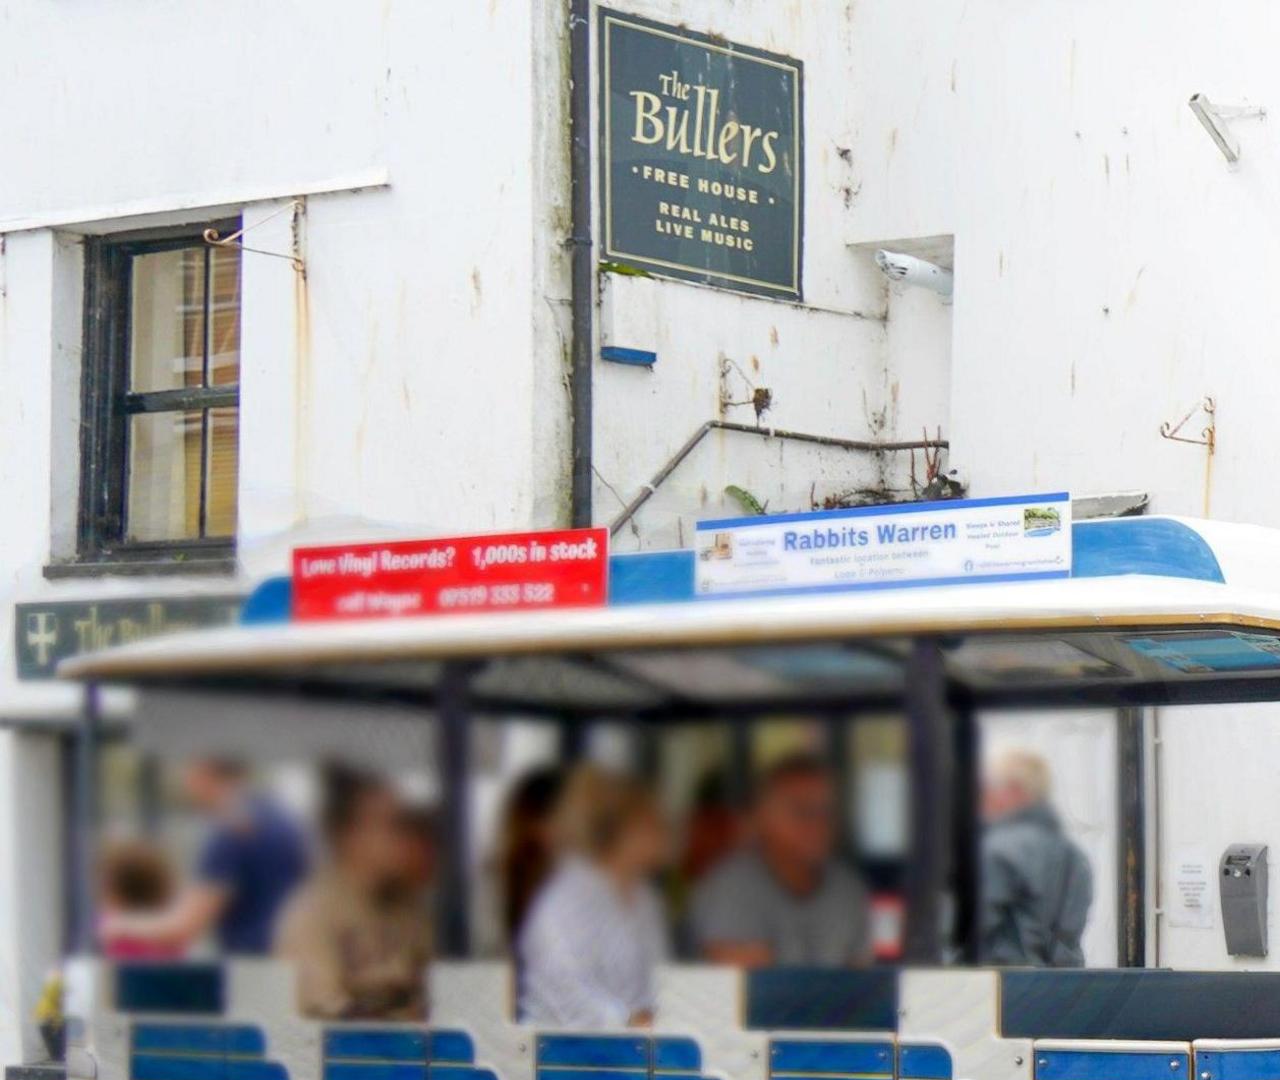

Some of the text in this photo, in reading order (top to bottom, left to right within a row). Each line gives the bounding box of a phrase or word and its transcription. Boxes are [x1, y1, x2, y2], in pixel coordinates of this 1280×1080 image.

[658, 70, 691, 100] The
[629, 85, 779, 174] Bullers
[643, 165, 759, 204] FREE HOUSE
[659, 201, 750, 232] REAL ALES
[656, 220, 754, 251] LIVE MUSIC
[783, 521, 957, 552] Rabbits Warren
[301, 538, 598, 578] Love Vinyl Records? 1,000s in stock
